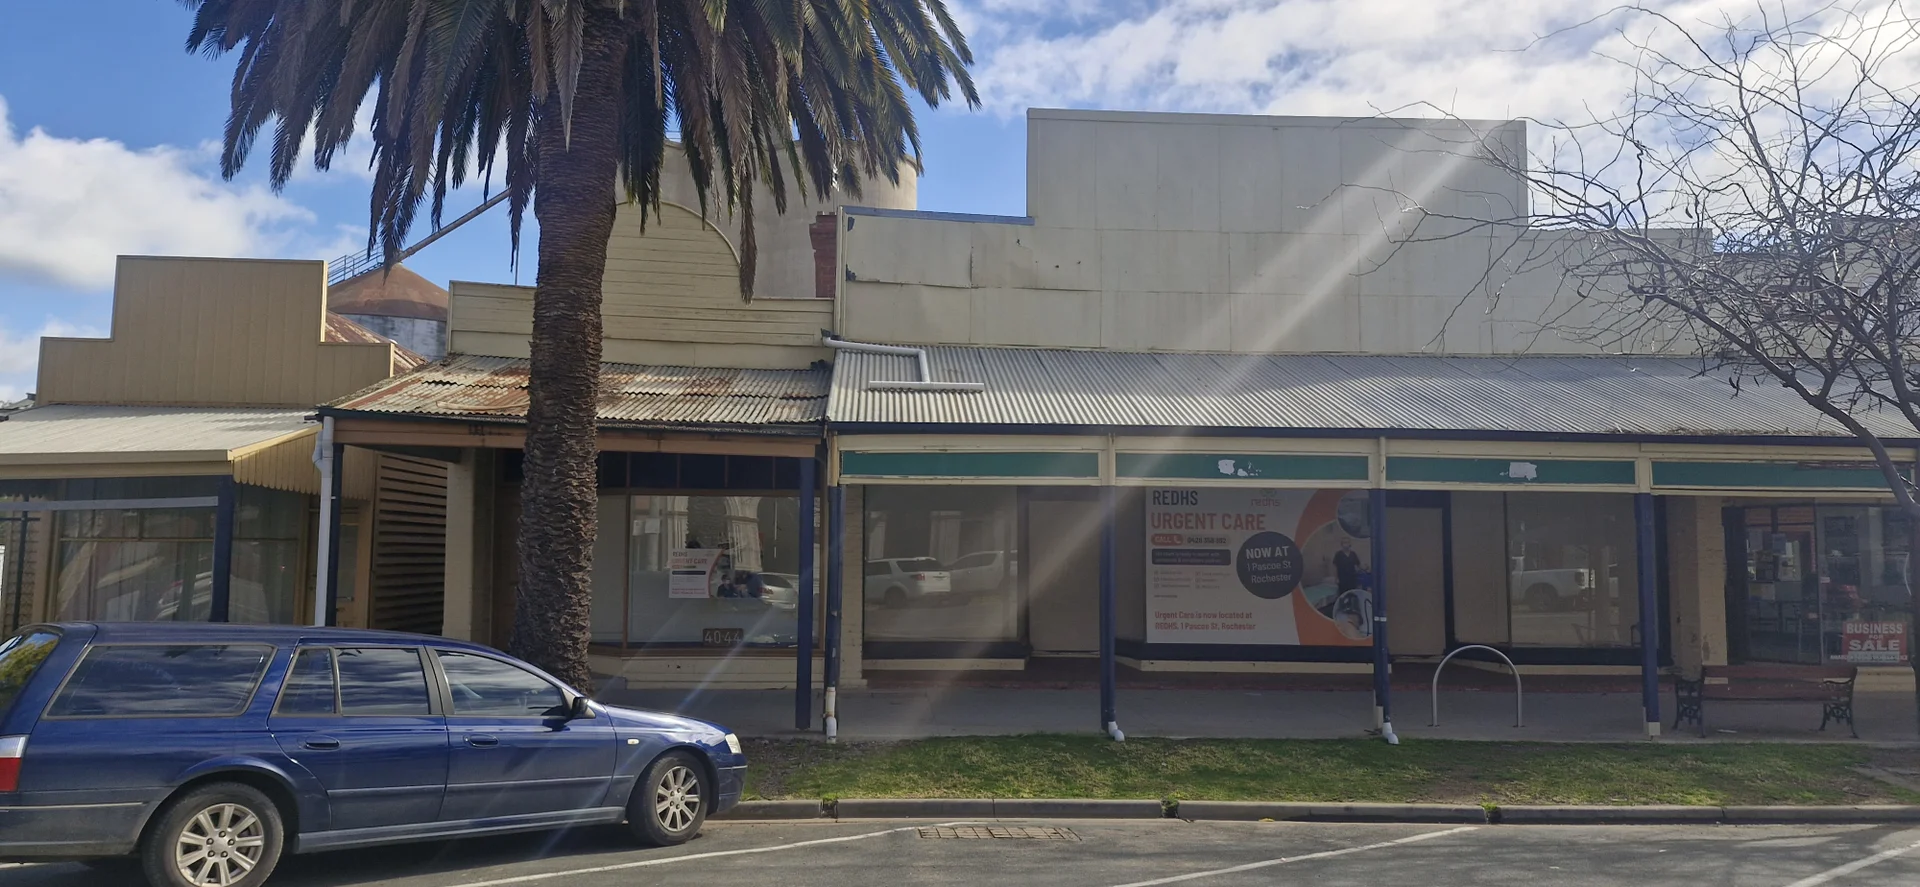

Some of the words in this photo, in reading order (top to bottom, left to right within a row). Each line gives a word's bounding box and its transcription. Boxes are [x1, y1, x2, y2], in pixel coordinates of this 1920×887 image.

[1152, 490, 1198, 506] REDHS
[1150, 512, 1217, 530] URGENT
[1222, 514, 1266, 530] CARE
[1154, 535, 1172, 544] CALL
[1246, 546, 1272, 560] NOW
[1274, 545, 1290, 557] AT
[1252, 562, 1282, 572] Pascoe
[1283, 560, 1292, 568] St
[1251, 573, 1292, 584] Rochester
[1154, 611, 1178, 620] Urgent
[1179, 611, 1194, 619] Care
[1196, 611, 1202, 619] is
[1218, 611, 1244, 619] located
[1221, 622, 1256, 630] Rochester
[1846, 623, 1903, 634] BUSINESS
[1848, 640, 1900, 651] SALE
